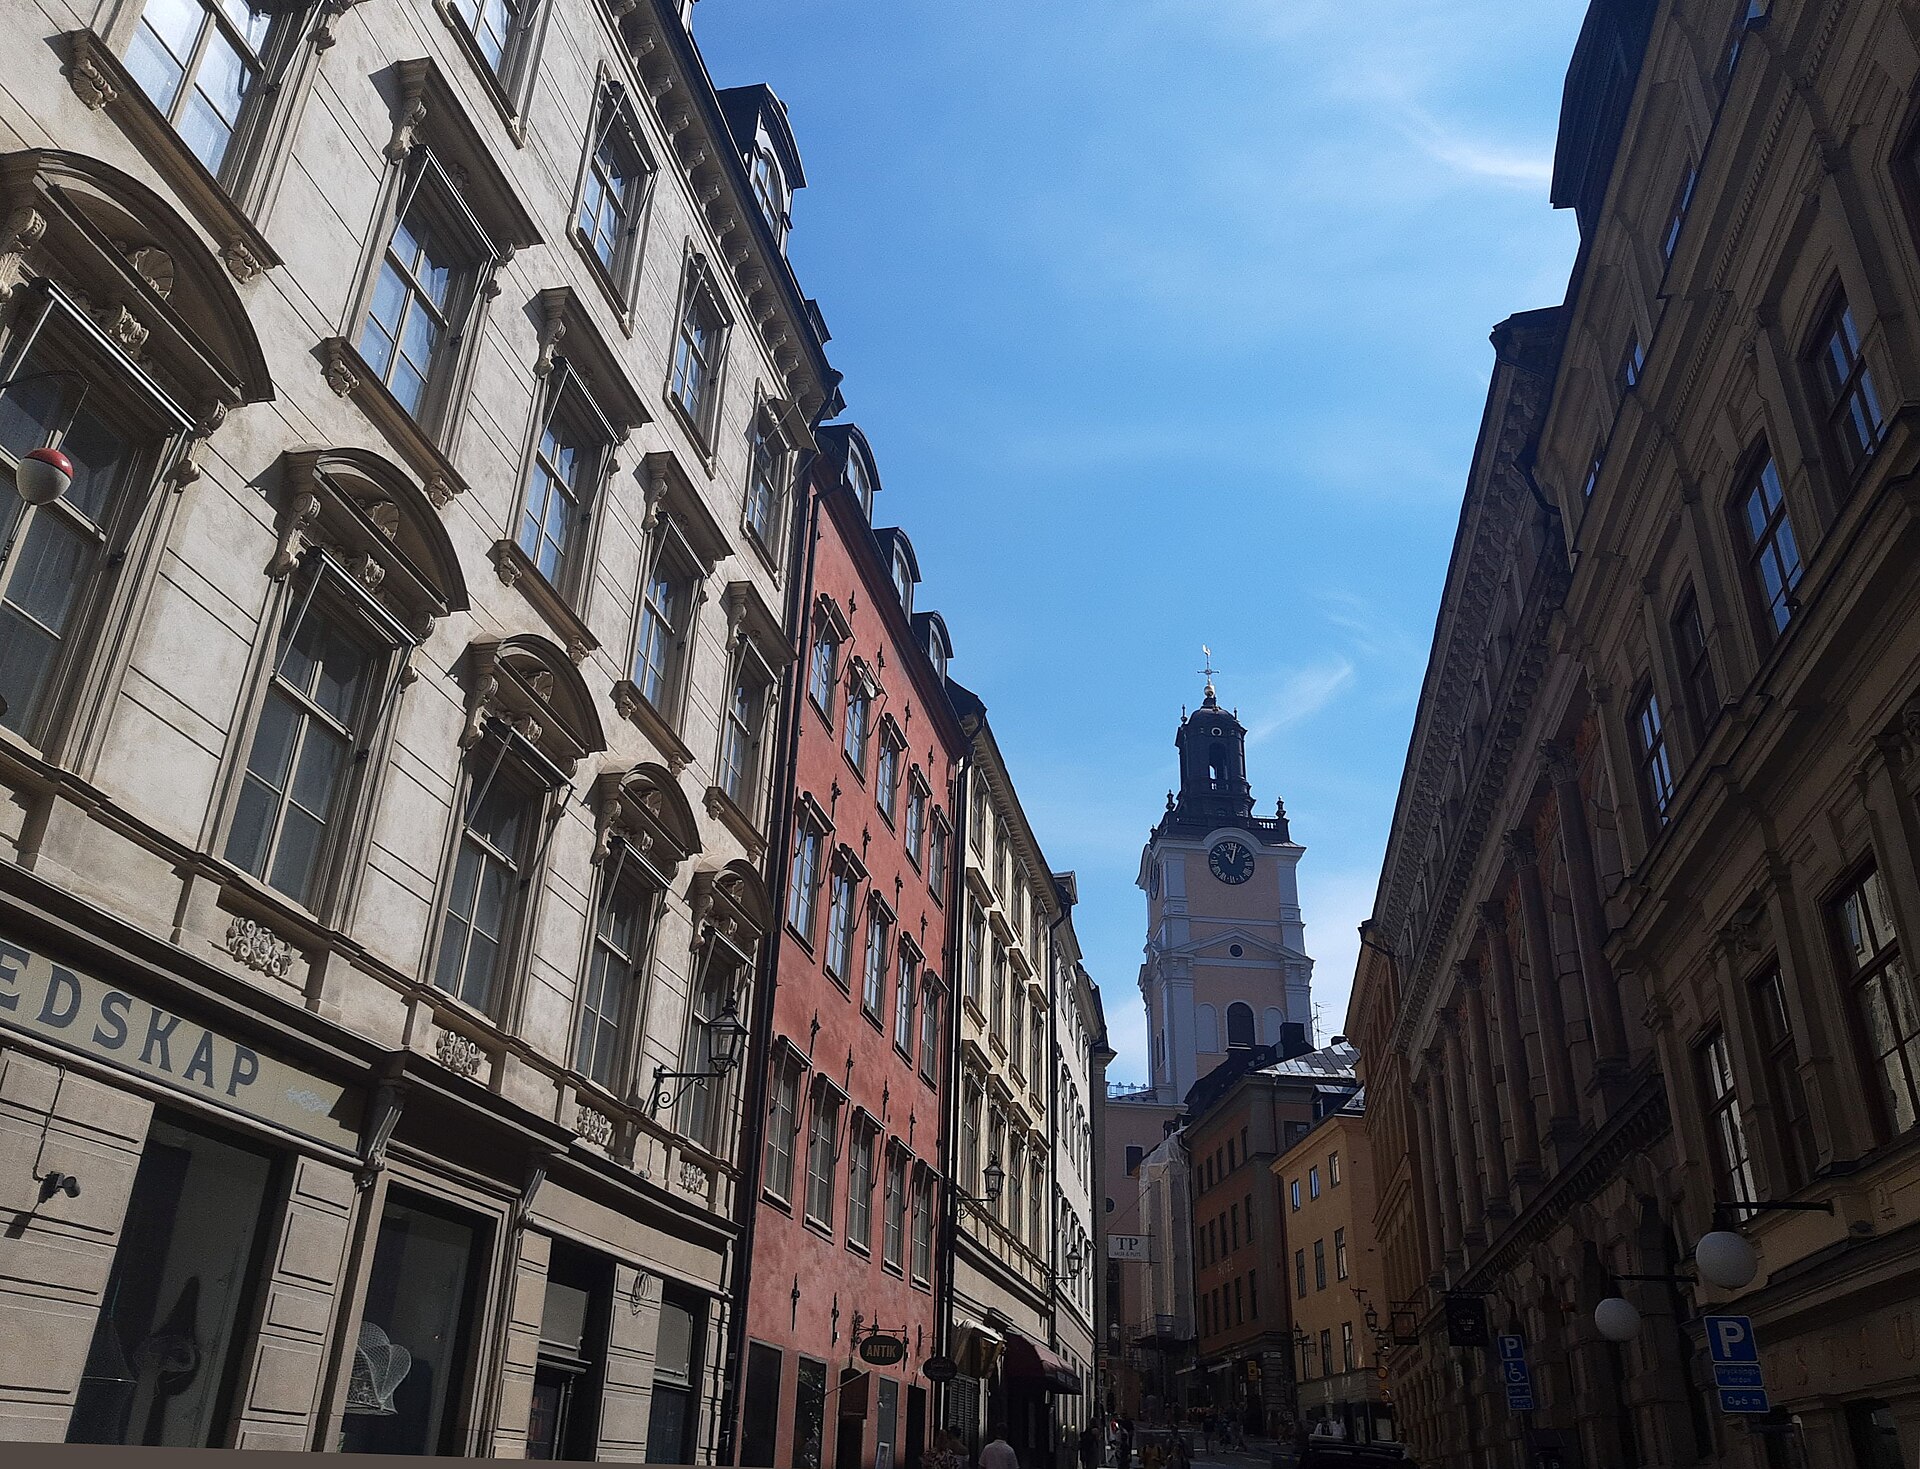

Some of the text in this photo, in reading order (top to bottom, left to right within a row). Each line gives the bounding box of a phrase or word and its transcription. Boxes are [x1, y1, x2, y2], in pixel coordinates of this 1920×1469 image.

[1116, 1237, 1138, 1250] TP
[1504, 1337, 1518, 1357] P
[1717, 1320, 1745, 1357] P
[866, 1344, 897, 1358] ANTIK
